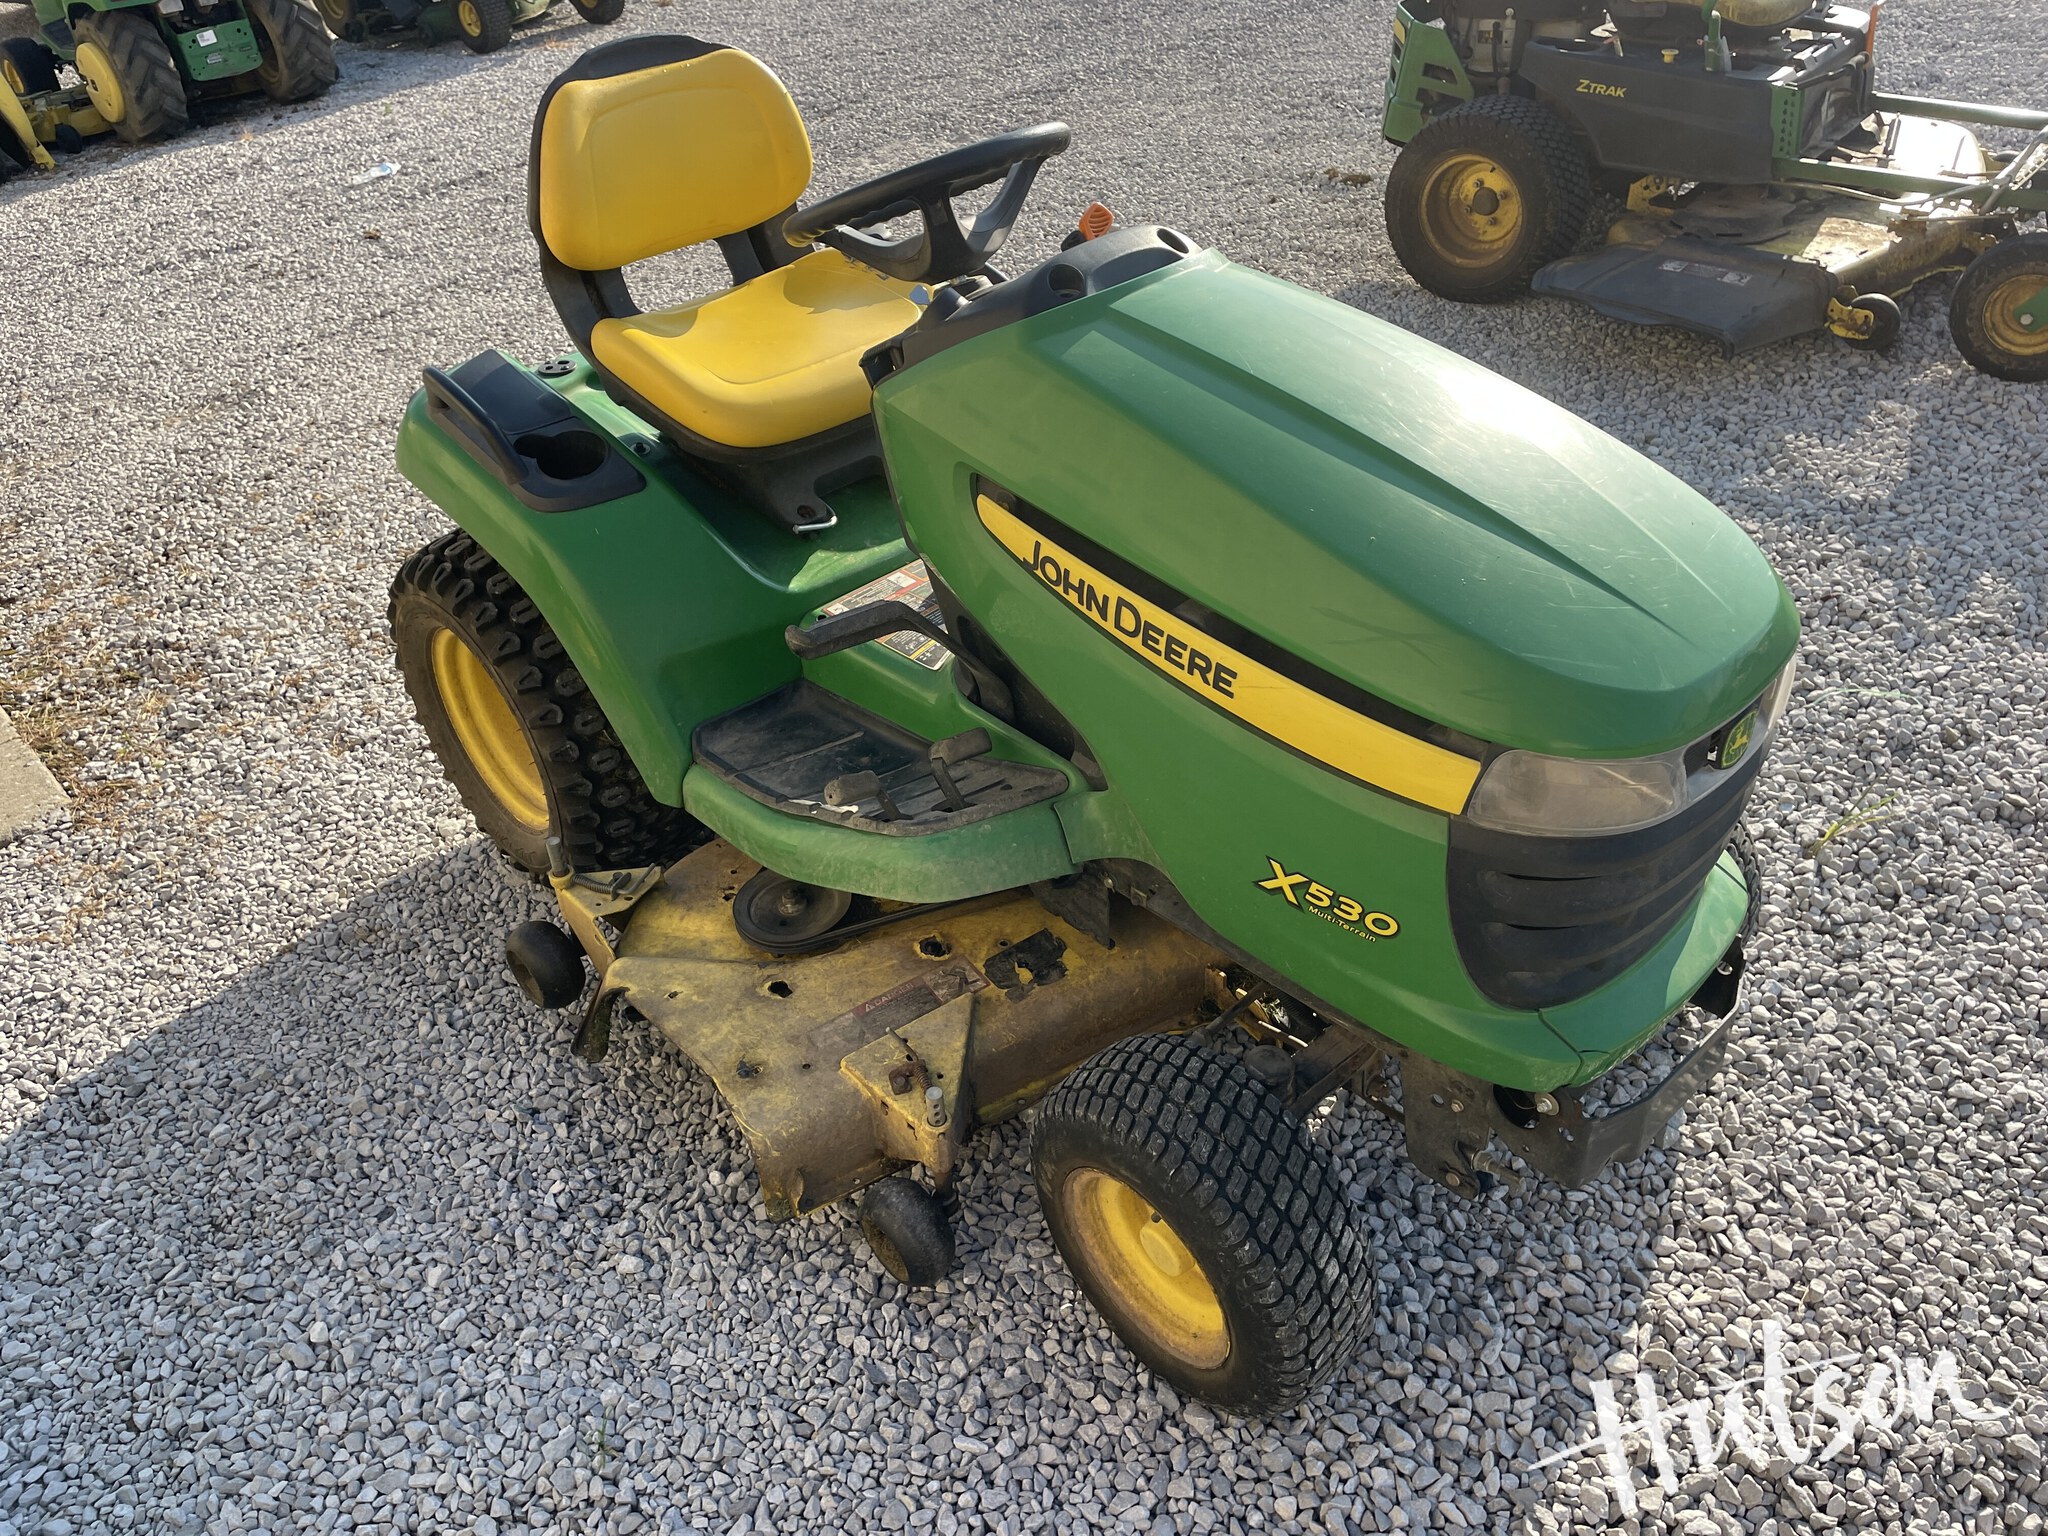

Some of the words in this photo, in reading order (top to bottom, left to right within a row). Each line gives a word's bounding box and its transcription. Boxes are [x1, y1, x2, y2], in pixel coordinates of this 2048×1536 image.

[1022, 541, 1110, 622] JOHN
[1114, 596, 1238, 699] DEERE
[1254, 857, 1400, 938] X530
[1308, 905, 1376, 942] Multi-Terrain
